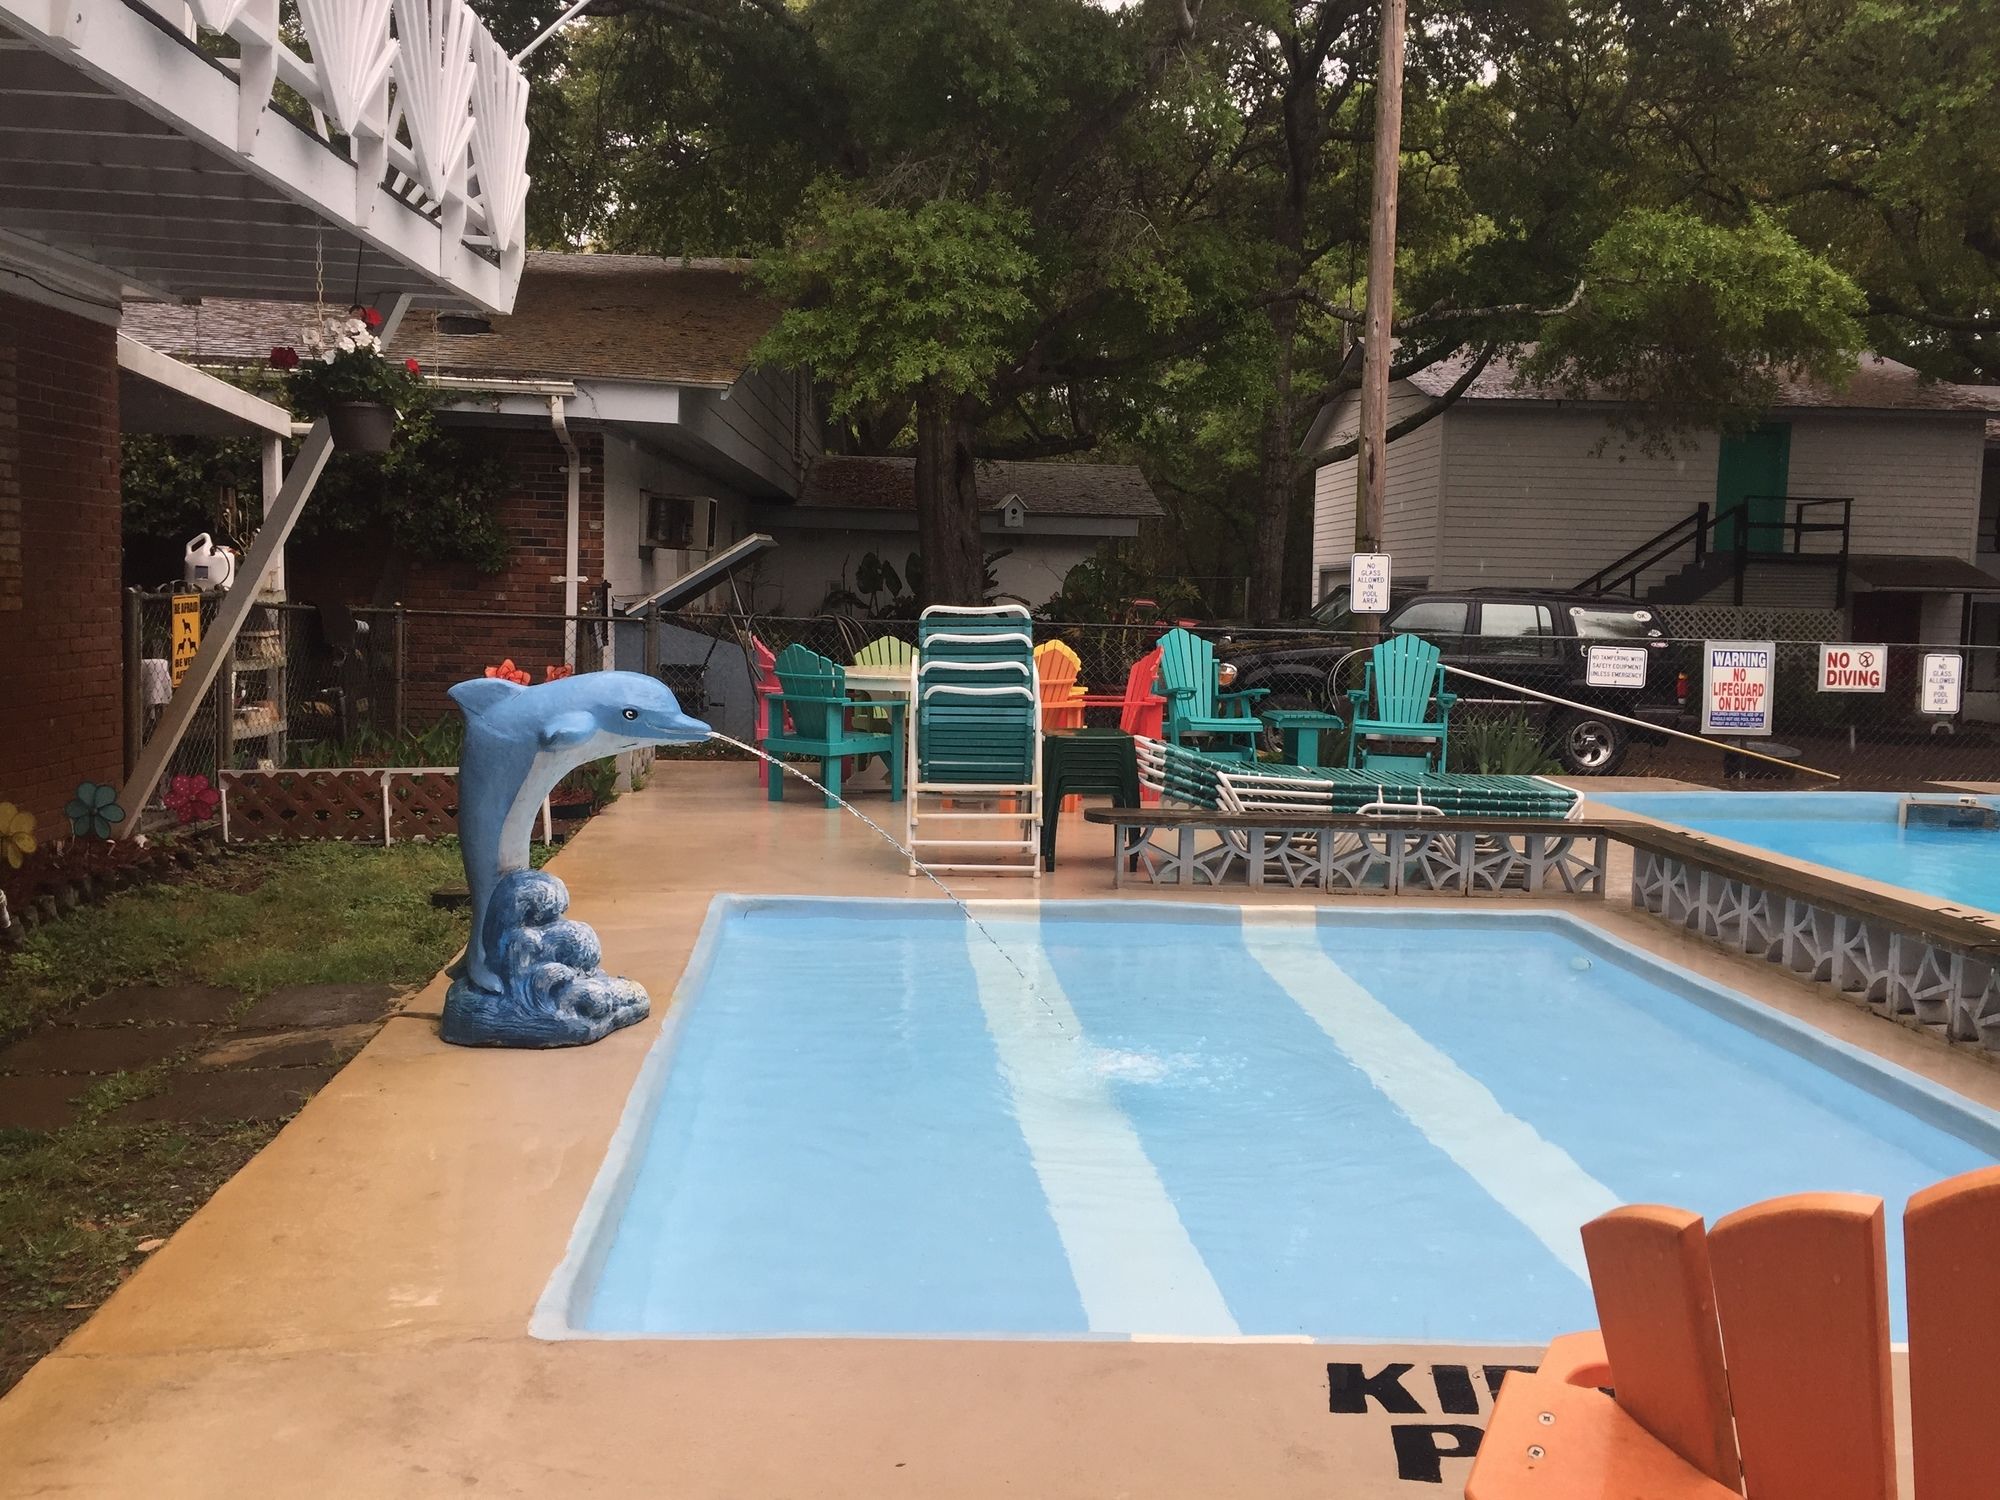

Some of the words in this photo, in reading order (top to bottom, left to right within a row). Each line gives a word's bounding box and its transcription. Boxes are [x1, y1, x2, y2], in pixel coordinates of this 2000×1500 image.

[1714, 651, 1766, 667] WARNING
[1827, 652, 1850, 669] NO
[1733, 668, 1746, 681] NO
[1826, 670, 1880, 686] DIVING
[1713, 682, 1764, 697] LIFEGUARD
[1718, 697, 1732, 710] ON
[1734, 697, 1758, 711] DUTY
